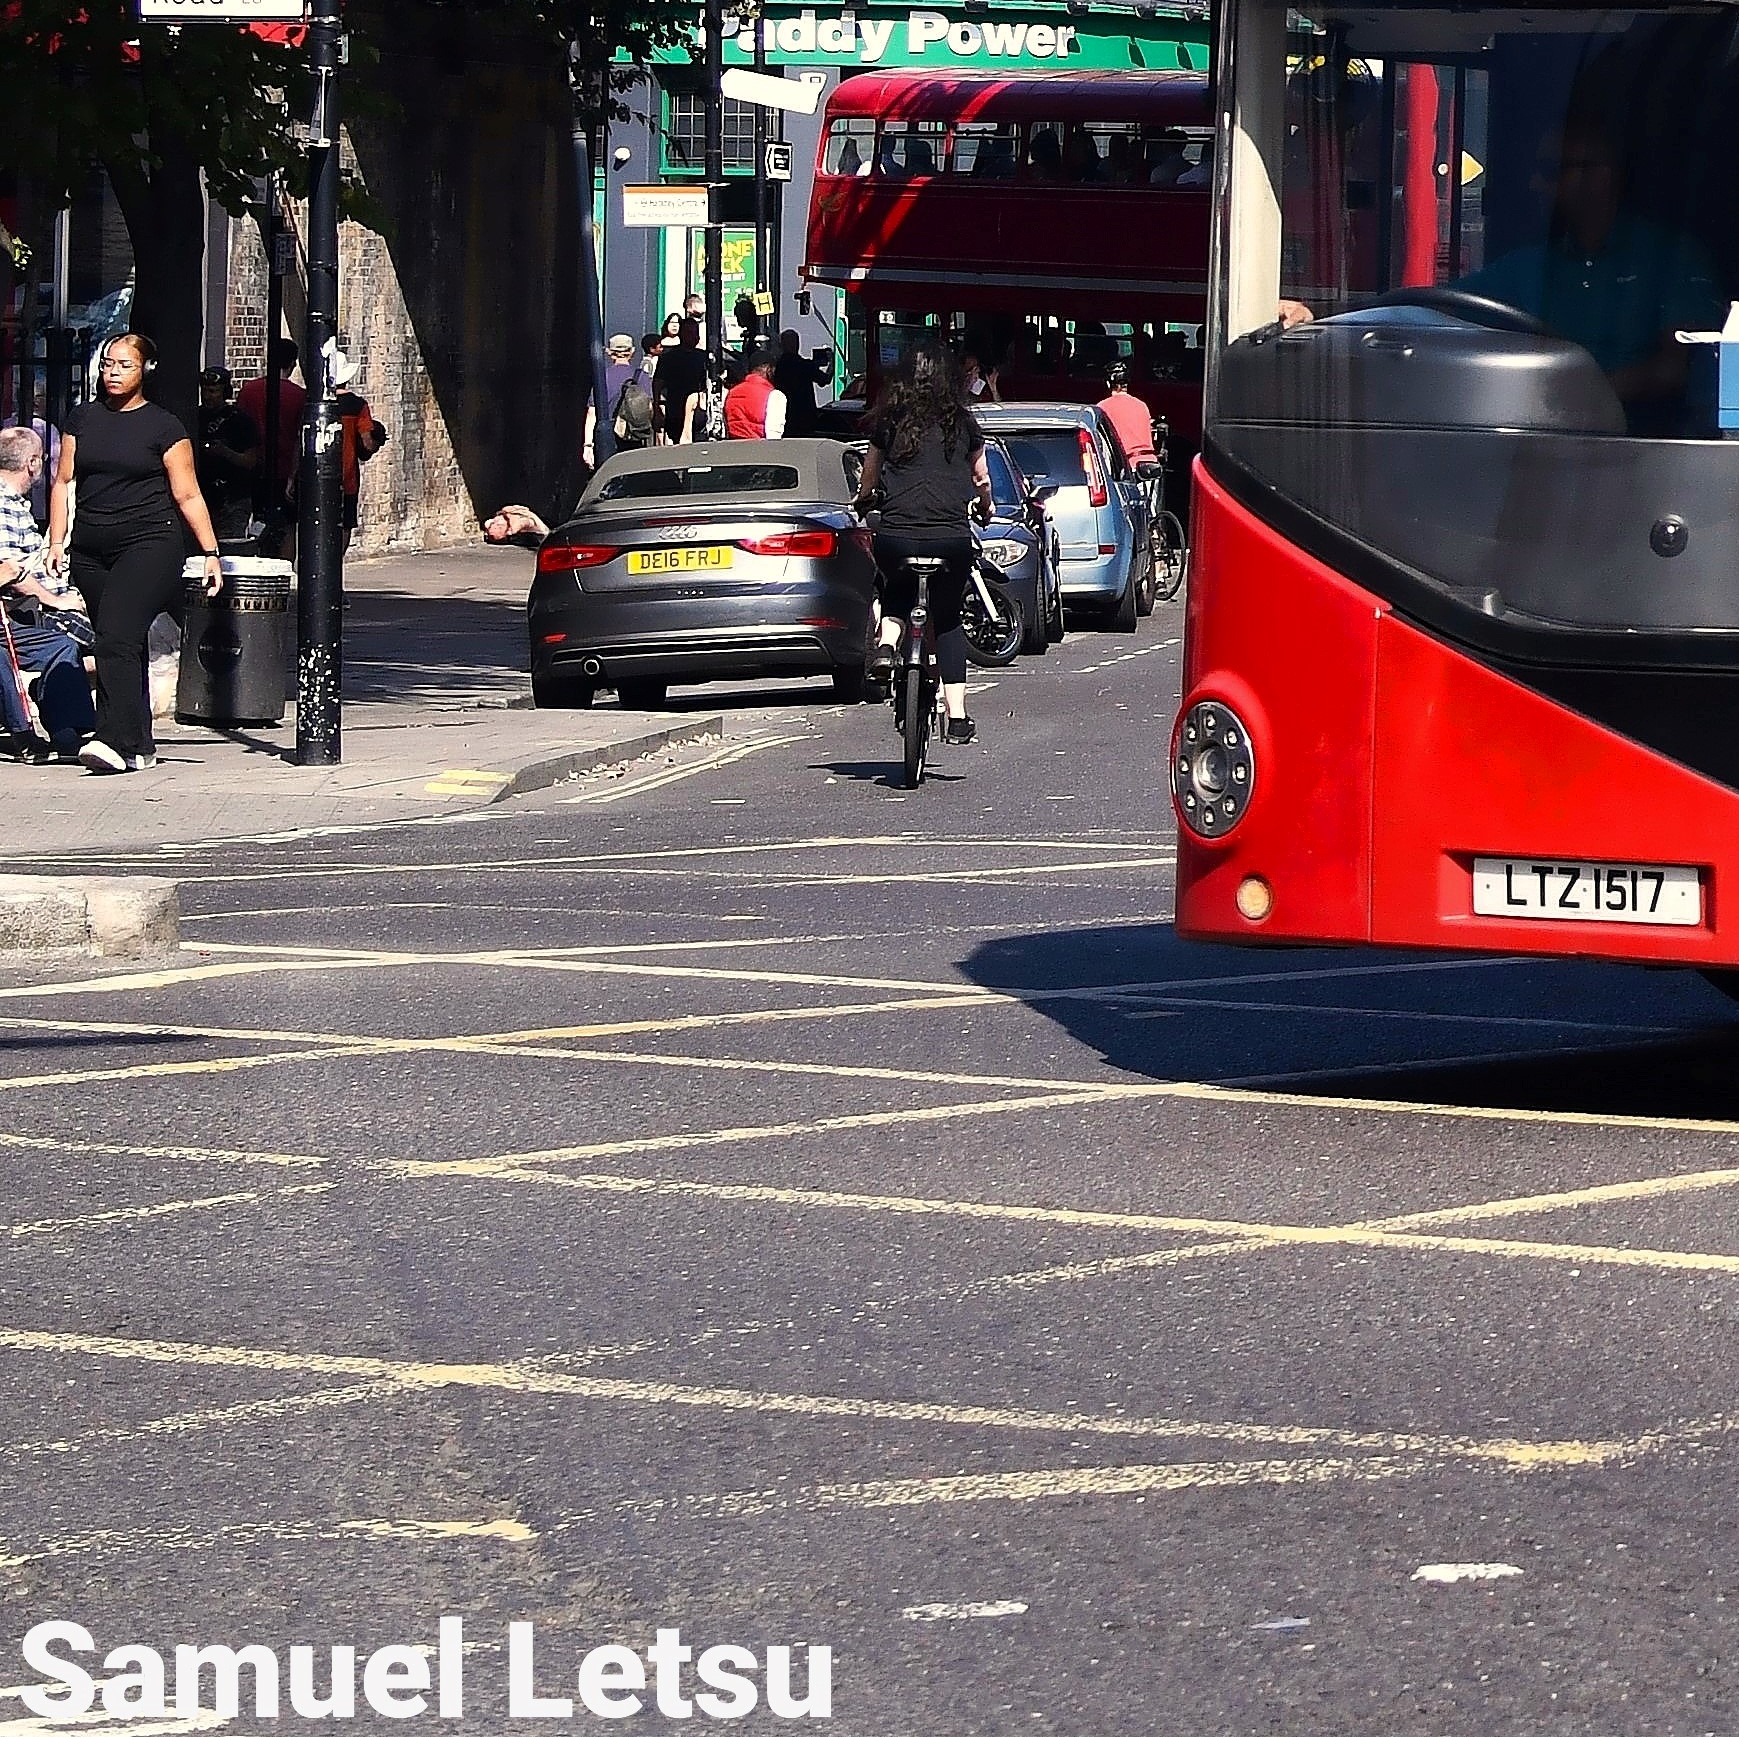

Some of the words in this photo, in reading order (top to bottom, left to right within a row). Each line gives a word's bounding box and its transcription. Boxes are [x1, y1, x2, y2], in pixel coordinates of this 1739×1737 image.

[908, 11, 1076, 60] Power
[640, 551, 680, 570] DE16
[685, 548, 721, 567] FRJ
[1504, 863, 1581, 909] LTZ
[1593, 867, 1666, 913] 1517
